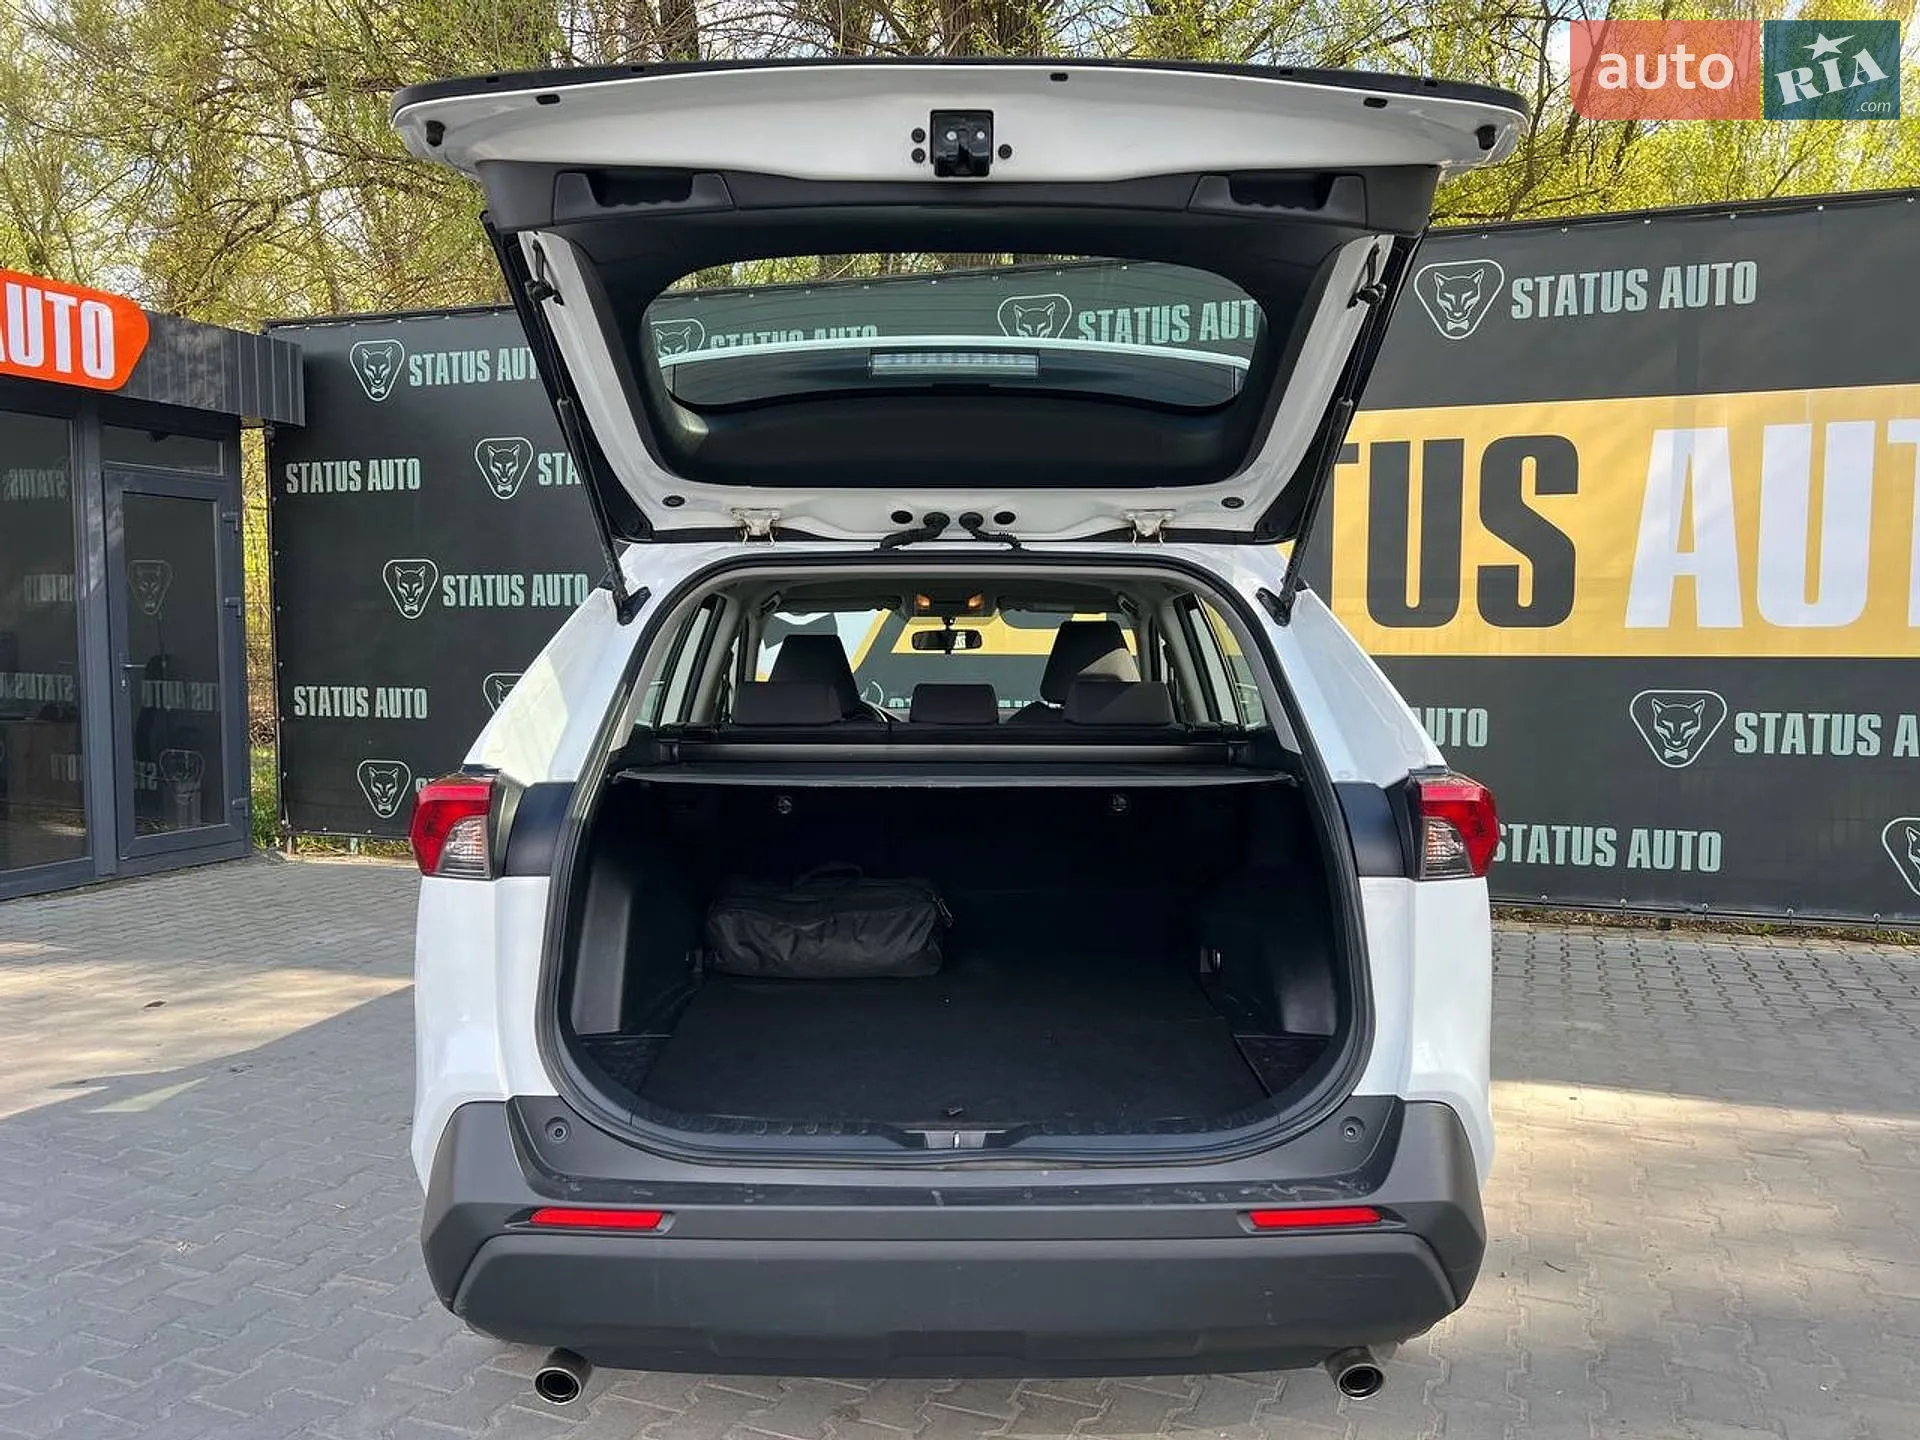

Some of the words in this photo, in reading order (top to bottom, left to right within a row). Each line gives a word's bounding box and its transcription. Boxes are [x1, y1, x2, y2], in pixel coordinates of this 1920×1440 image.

[1511, 267, 1649, 320] STATUS
[1658, 260, 1758, 310] AUTO
[0, 281, 116, 380] UTO
[1077, 304, 1190, 344] STATUS
[409, 350, 491, 387] STATUS
[285, 459, 362, 494] STATUS
[367, 458, 422, 492] AUTO
[442, 573, 525, 608] STATUS
[531, 573, 589, 607] AUTO
[293, 686, 369, 718] STATUS
[374, 687, 429, 720] AUTO
[1733, 712, 1882, 756] STATUS
[1627, 828, 1722, 873] AUTO
